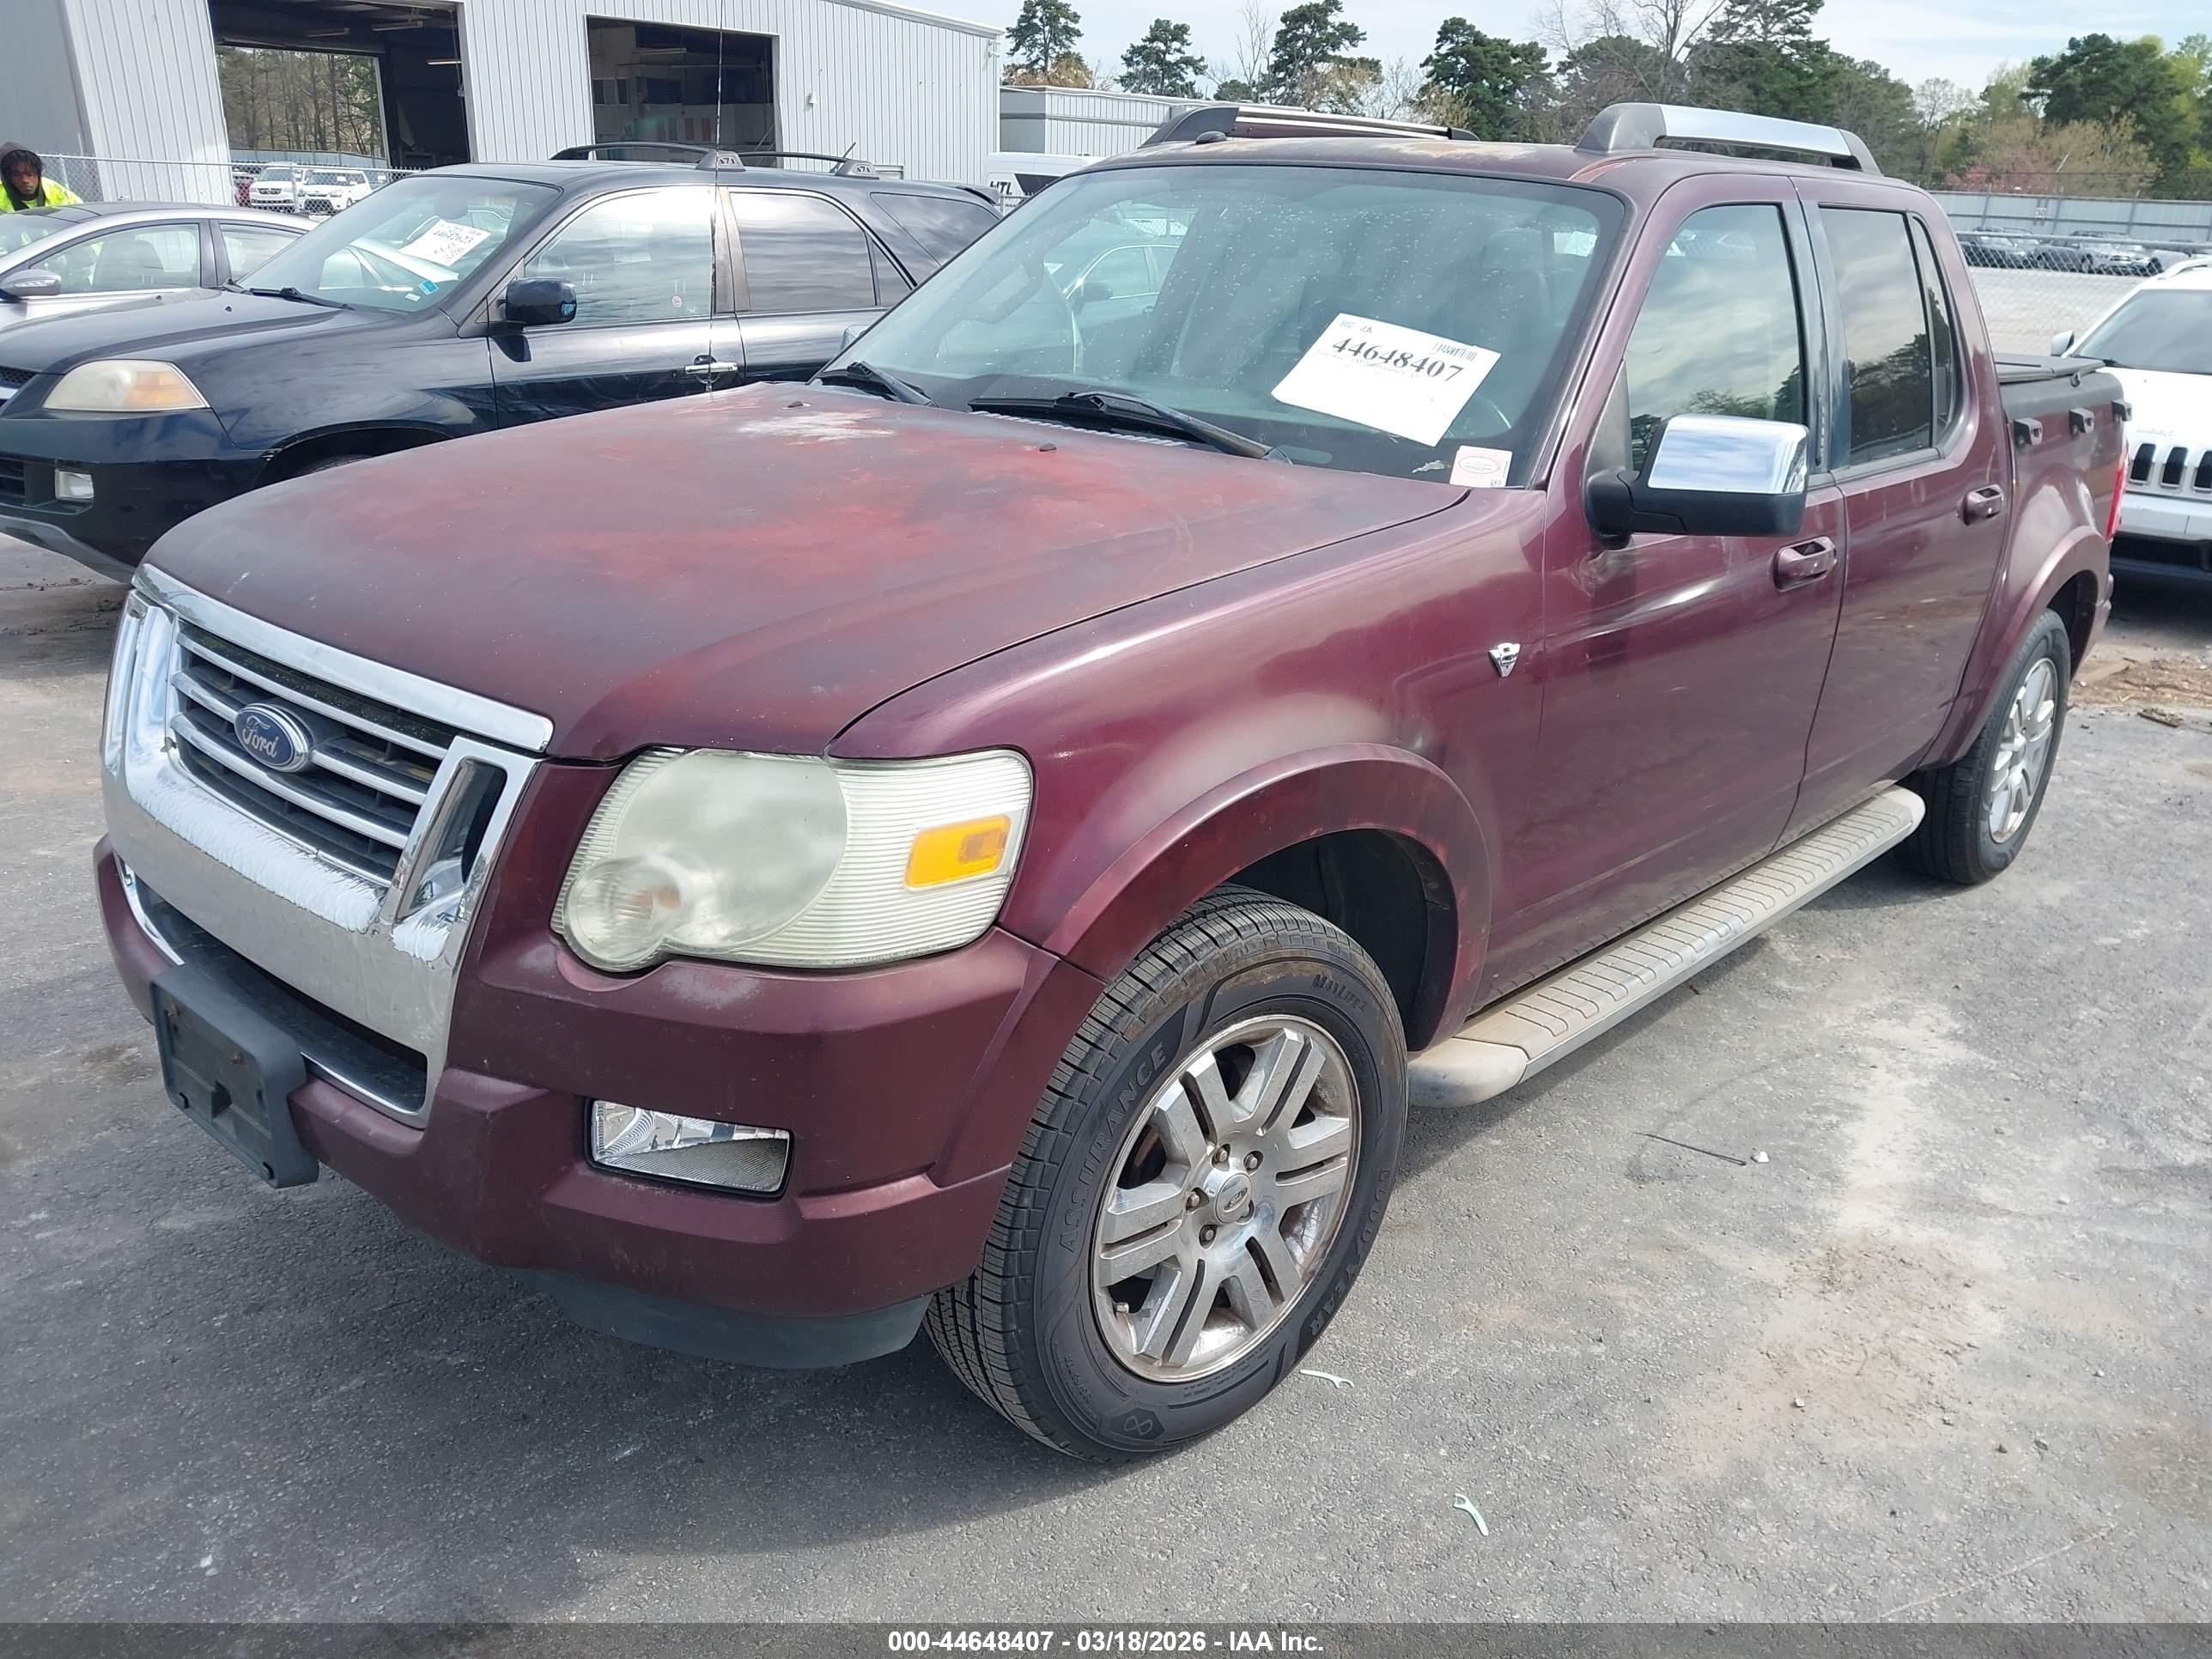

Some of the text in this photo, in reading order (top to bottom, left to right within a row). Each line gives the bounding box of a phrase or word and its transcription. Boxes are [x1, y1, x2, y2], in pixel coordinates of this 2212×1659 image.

[1333, 337, 1464, 382] 44648407
[242, 714, 279, 758] Ford
[1059, 1040, 1169, 1254] ASSURANCE
